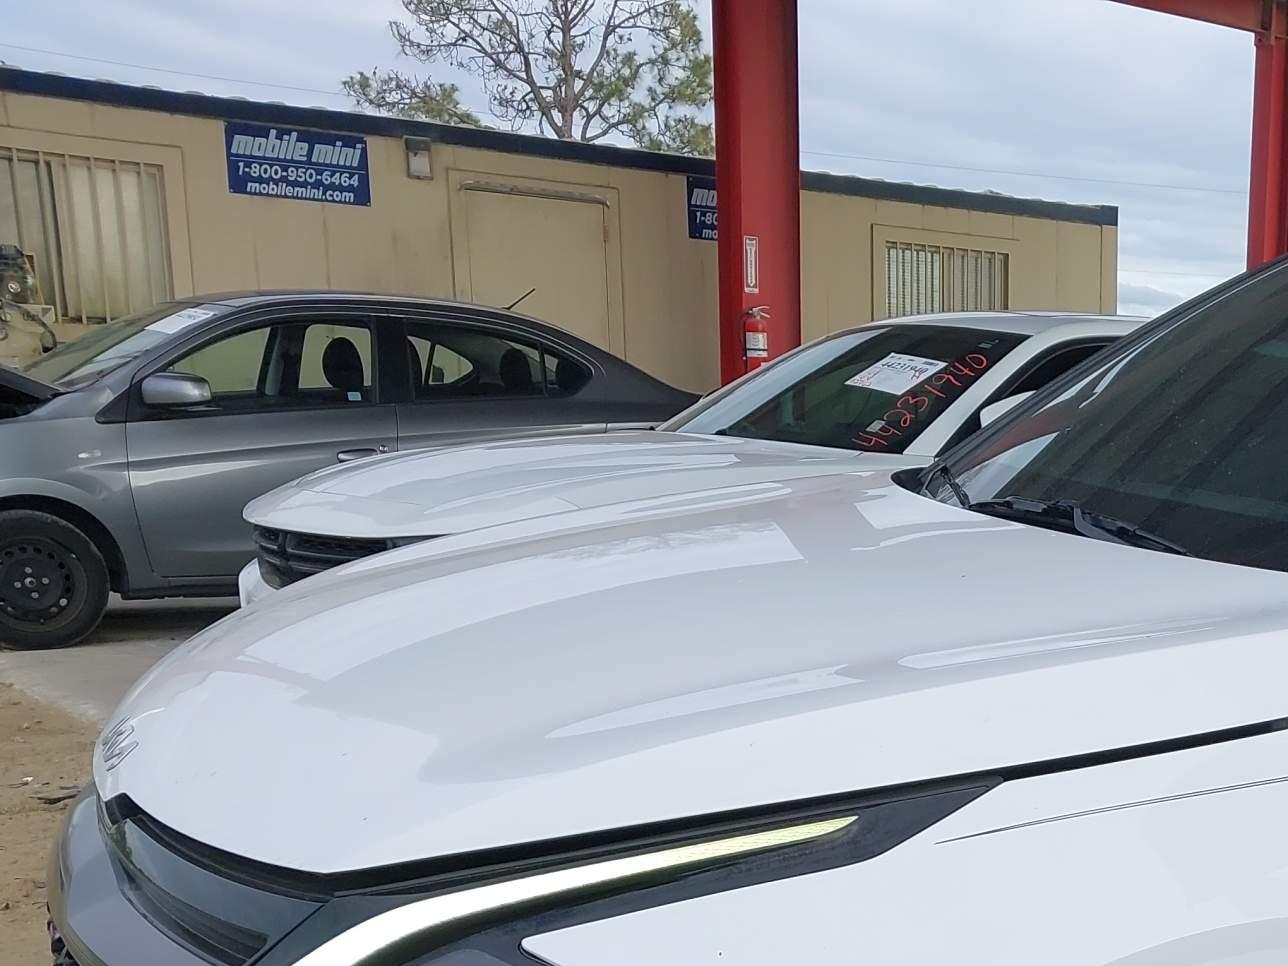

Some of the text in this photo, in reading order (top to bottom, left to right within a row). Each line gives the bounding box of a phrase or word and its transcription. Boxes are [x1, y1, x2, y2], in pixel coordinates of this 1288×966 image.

[230, 129, 363, 167] mobile mini
[237, 161, 359, 188] 1-800-950-6464
[246, 181, 355, 203] mobilemini.com
[851, 353, 988, 447] 44231940
